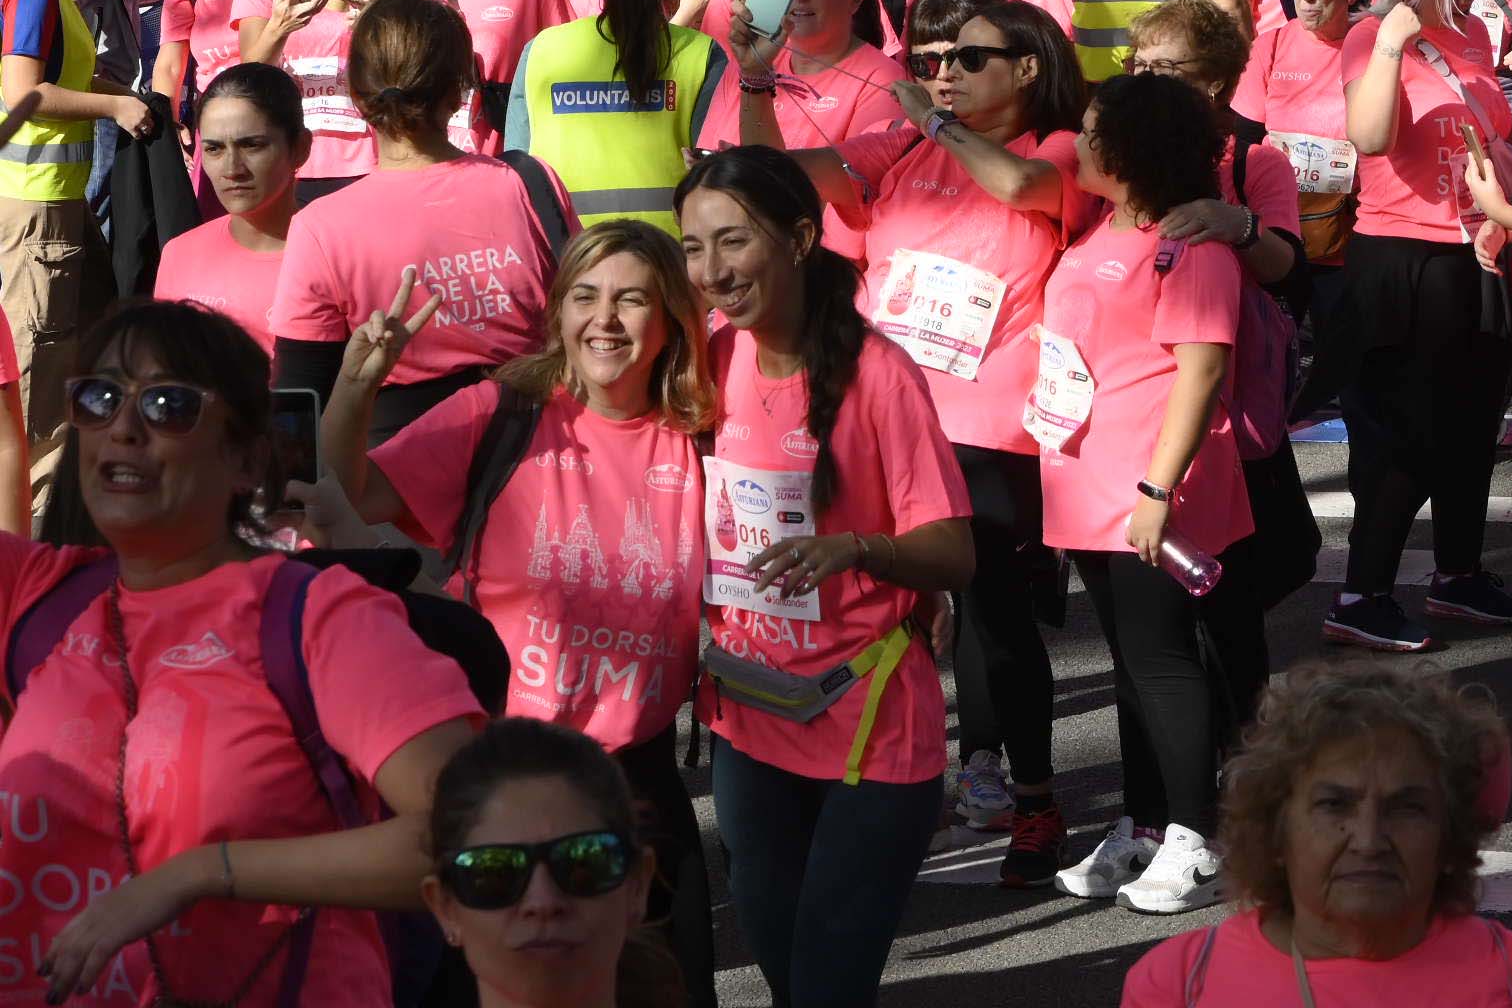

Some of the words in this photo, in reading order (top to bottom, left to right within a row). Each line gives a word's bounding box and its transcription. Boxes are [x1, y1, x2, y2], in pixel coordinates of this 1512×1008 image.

[202, 44, 230, 64] TU
[1272, 71, 1312, 81] OYSHO
[401, 244, 522, 287] CARRERA
[471, 271, 505, 295] LA
[434, 294, 512, 329] MUJER
[775, 492, 802, 501] SUMA
[738, 523, 771, 548] 016
[718, 583, 750, 598] OYSHO
[527, 615, 561, 644] TU
[570, 625, 682, 658] DORSAL
[516, 644, 664, 704] SUMA
